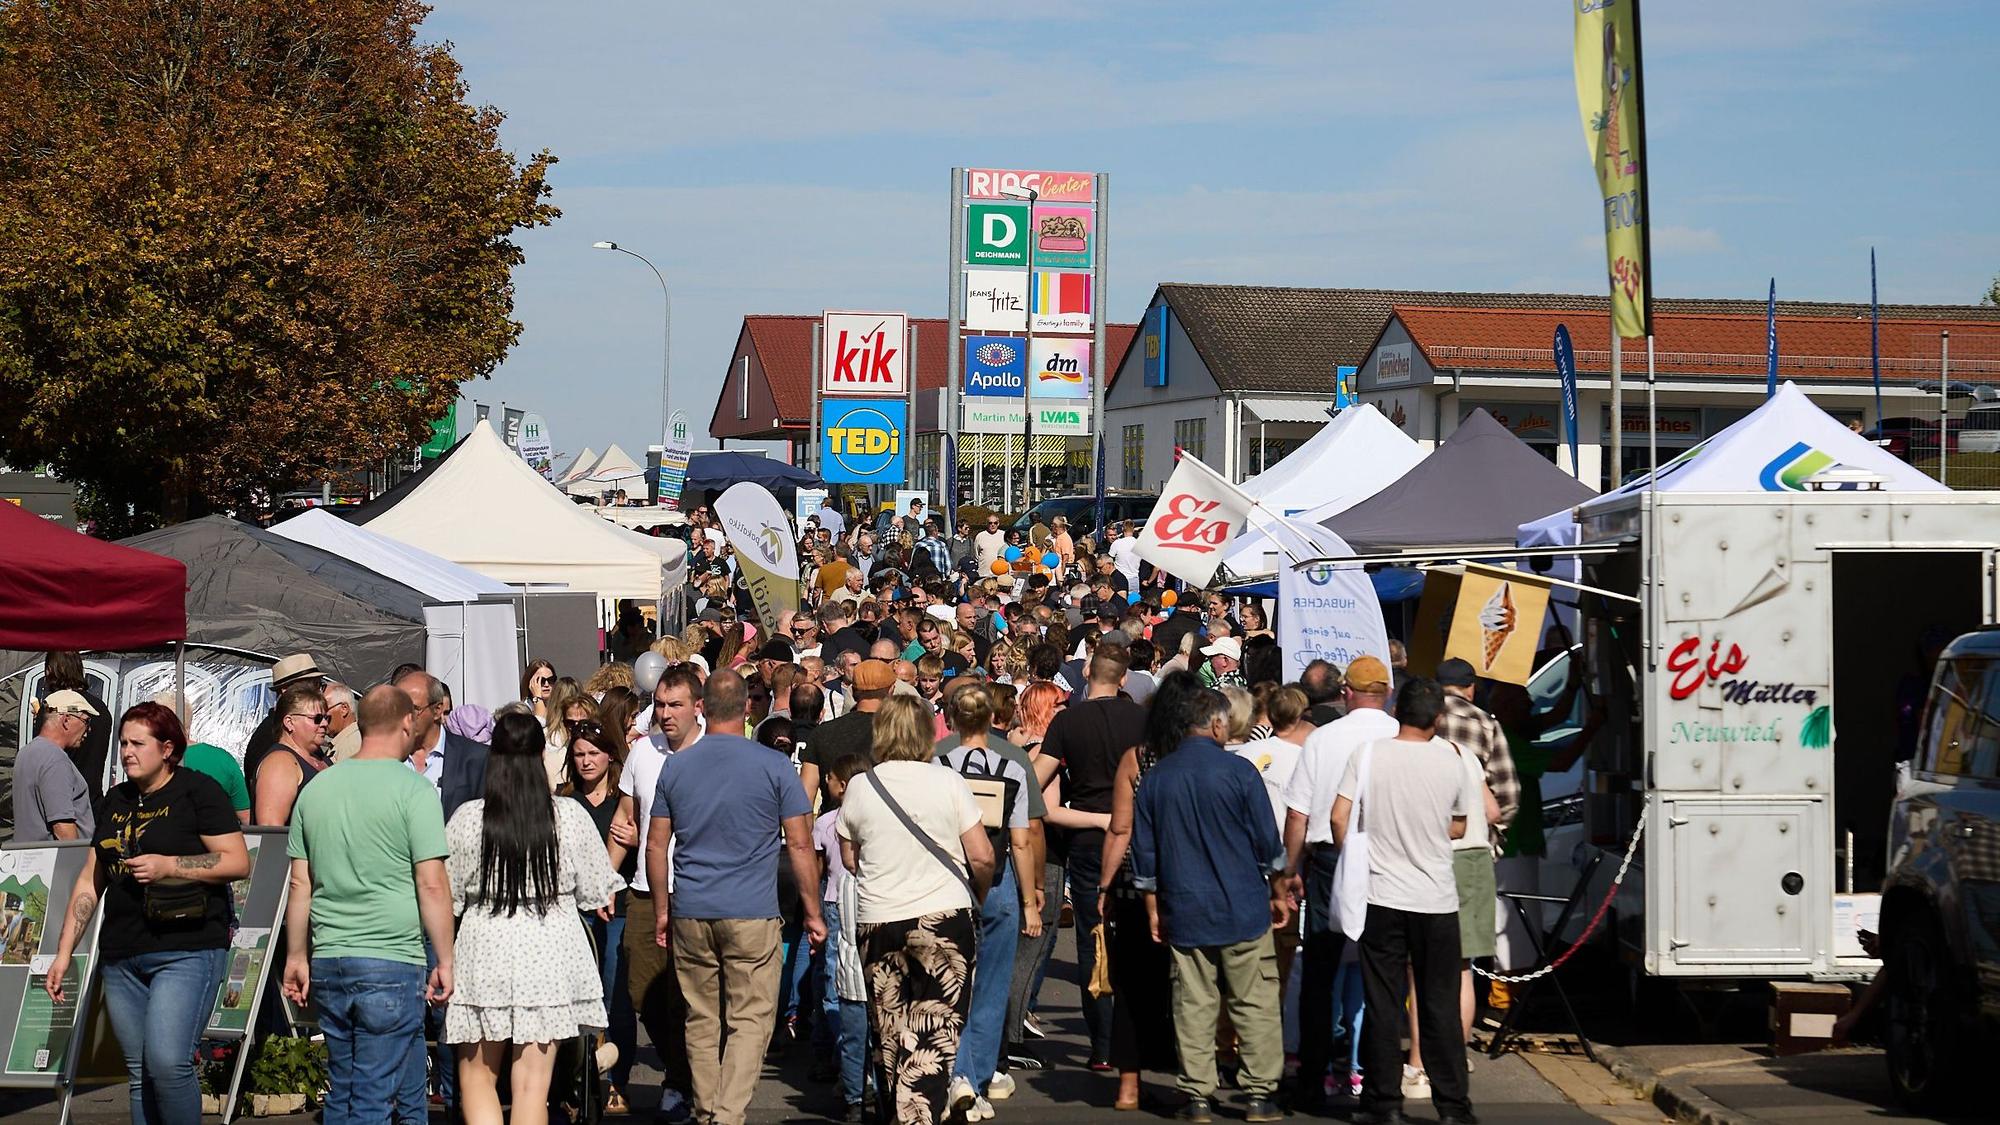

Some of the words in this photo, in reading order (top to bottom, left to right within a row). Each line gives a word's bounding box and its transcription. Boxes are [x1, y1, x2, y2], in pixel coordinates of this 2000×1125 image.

[1040, 175, 1090, 198] Center
[975, 251, 1021, 259] DEICHMANN
[969, 290, 992, 298] JEANS
[987, 287, 1024, 313] fritz
[1063, 319, 1084, 328] family
[1046, 353, 1078, 372] dm
[970, 371, 1021, 390] Apollo
[972, 412, 1006, 423] Martin
[1040, 410, 1067, 424] LVM
[1606, 416, 1692, 432] Jnnihes
[826, 426, 900, 456] TEDi
[1153, 493, 1232, 546] Eis
[1666, 636, 1749, 701] Eis
[1720, 679, 1817, 706] Müller
[1670, 717, 1783, 744] Neuwied
